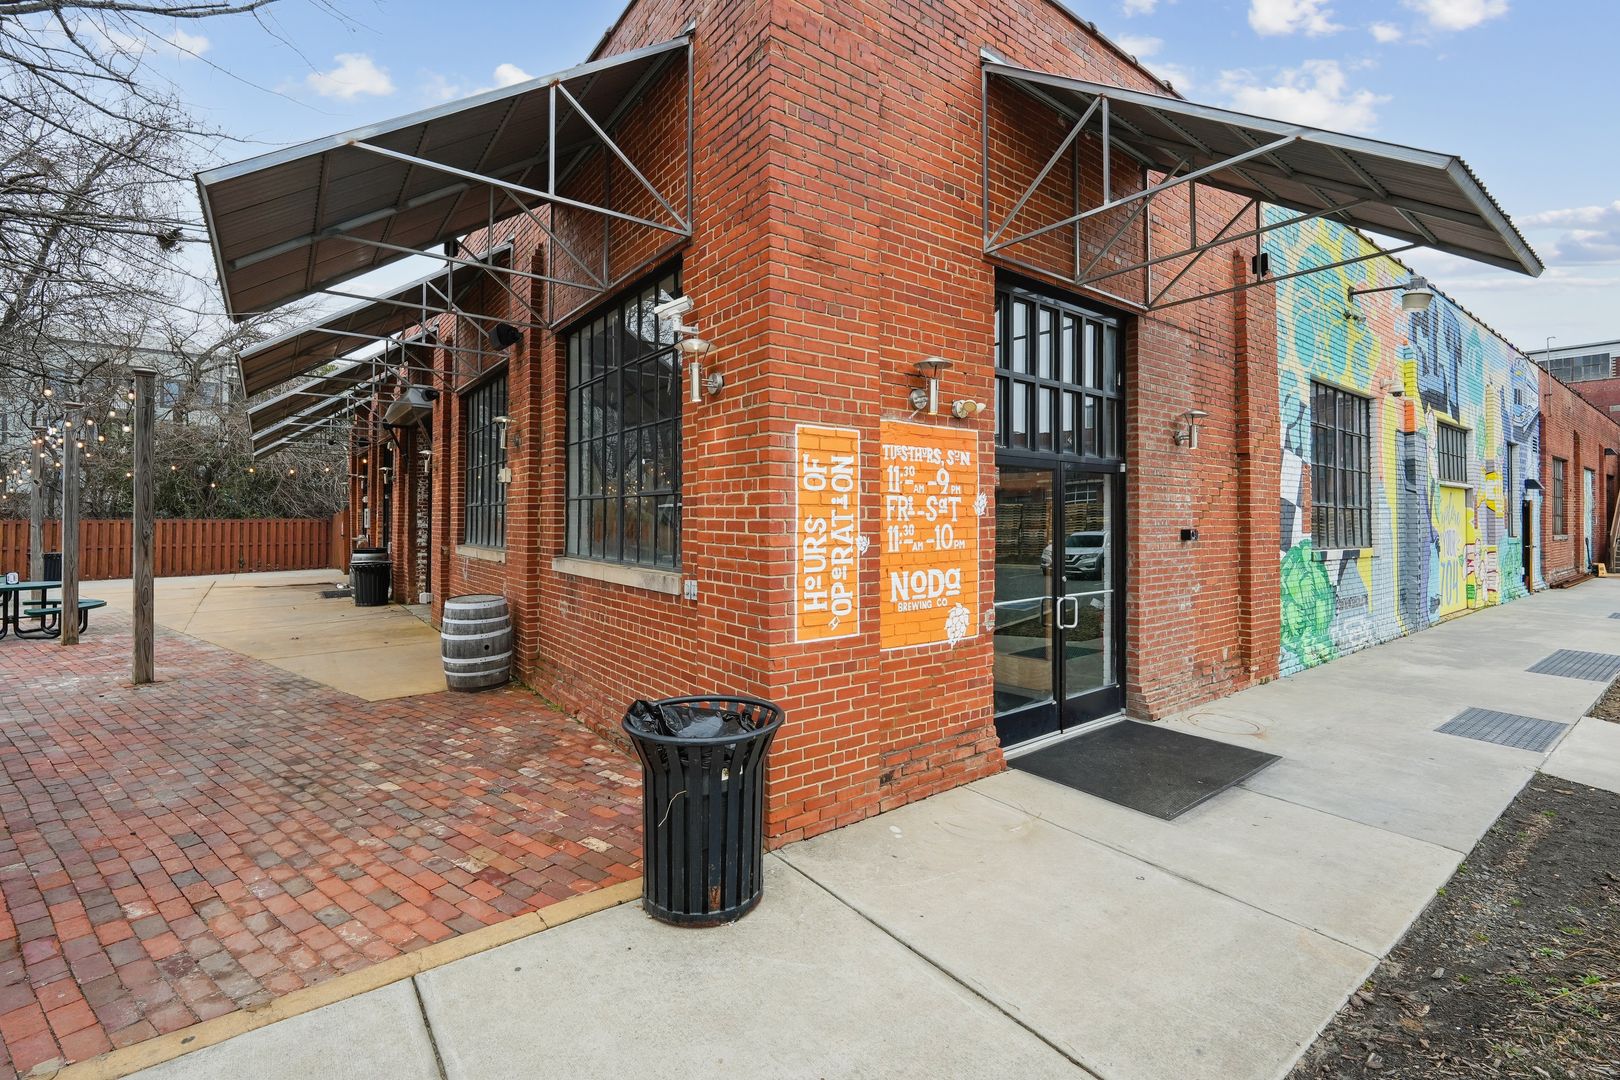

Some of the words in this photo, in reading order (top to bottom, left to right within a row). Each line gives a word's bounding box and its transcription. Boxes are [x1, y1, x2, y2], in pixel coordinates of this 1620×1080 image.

[803, 453, 828, 492] OF
[897, 600, 932, 613] BREWING
[936, 597, 948, 607] CO
